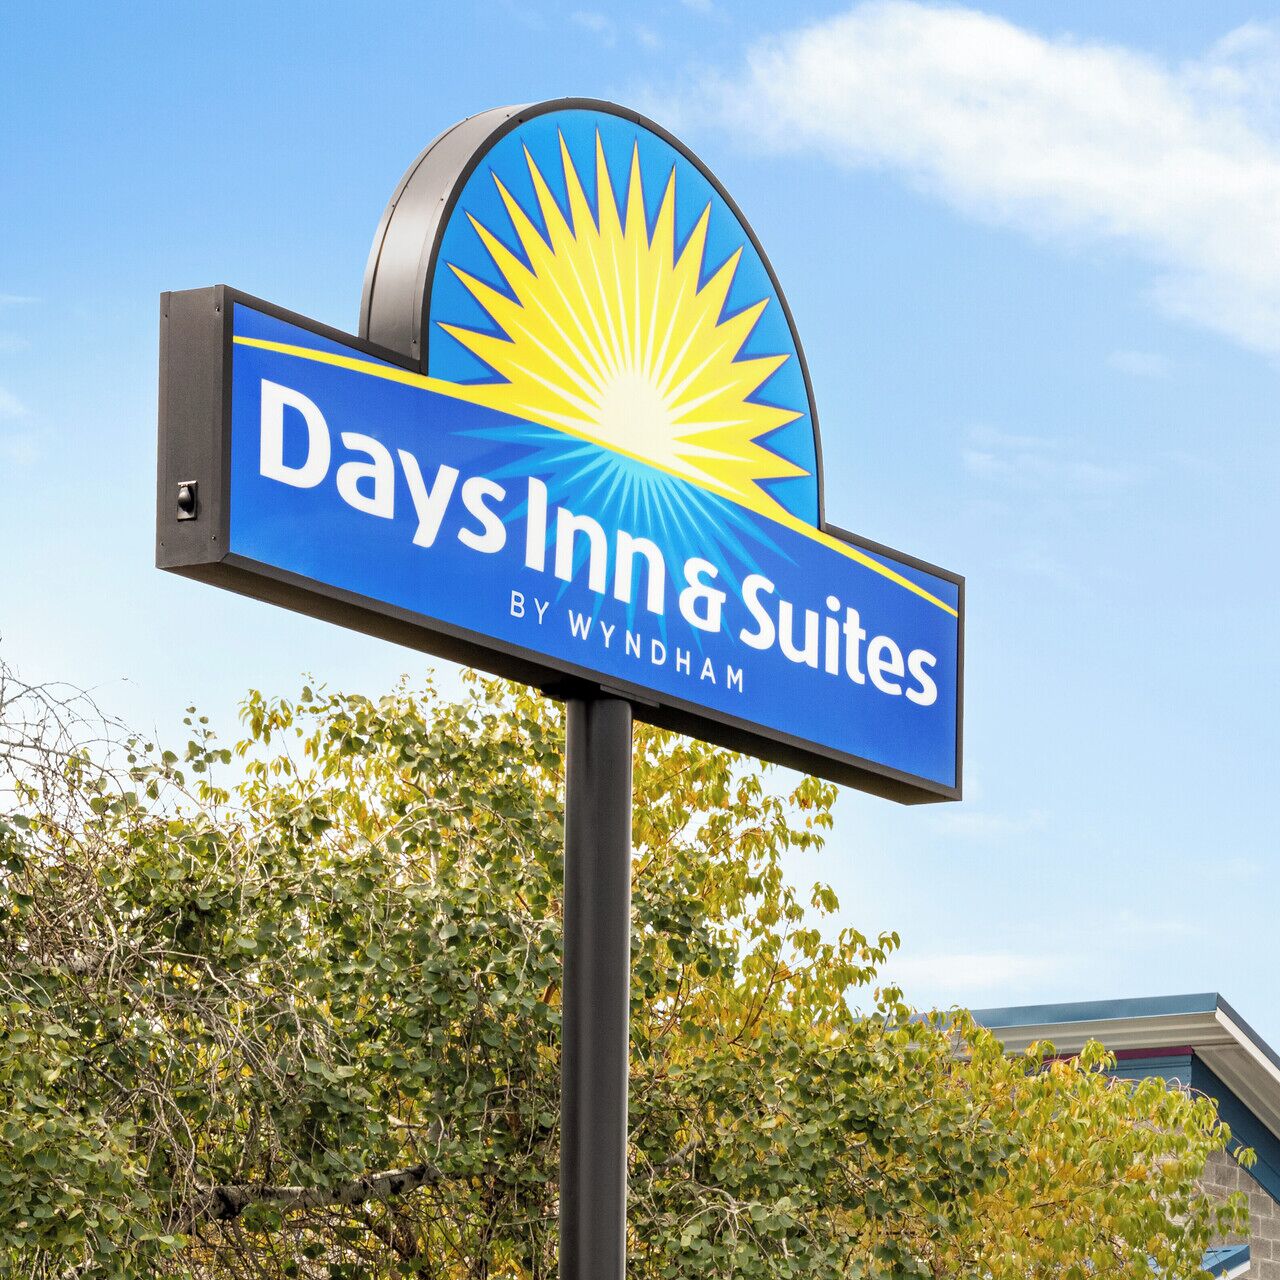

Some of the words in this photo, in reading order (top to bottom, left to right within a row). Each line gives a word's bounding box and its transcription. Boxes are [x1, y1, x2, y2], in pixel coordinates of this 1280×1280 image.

[259, 378, 507, 554] Days
[525, 476, 666, 616] Inn
[679, 558, 727, 633] &
[740, 573, 938, 706] Suites
[510, 590, 549, 625] BY
[568, 609, 743, 693] WYNDHAM
